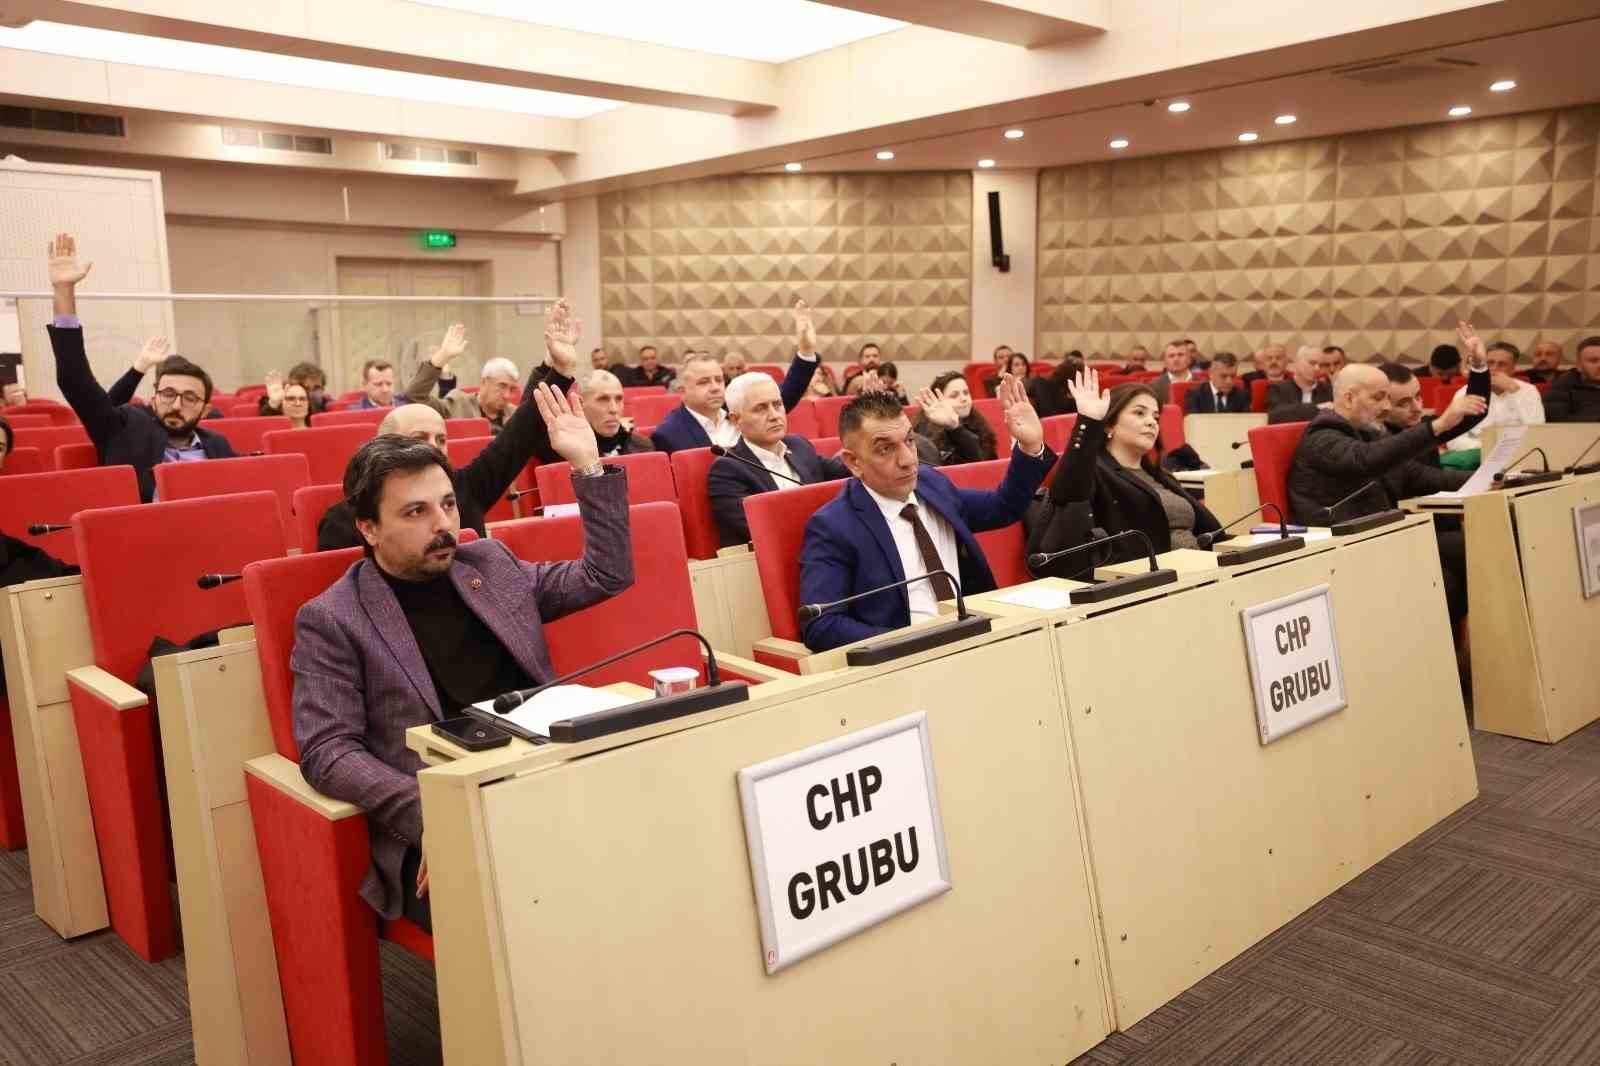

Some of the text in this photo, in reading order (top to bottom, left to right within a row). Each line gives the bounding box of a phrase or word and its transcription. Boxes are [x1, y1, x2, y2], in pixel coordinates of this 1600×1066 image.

[1274, 615, 1311, 656] CHP
[1269, 659, 1332, 713] GRUBU
[806, 765, 883, 831] CHP
[787, 826, 920, 920] GRUBU
